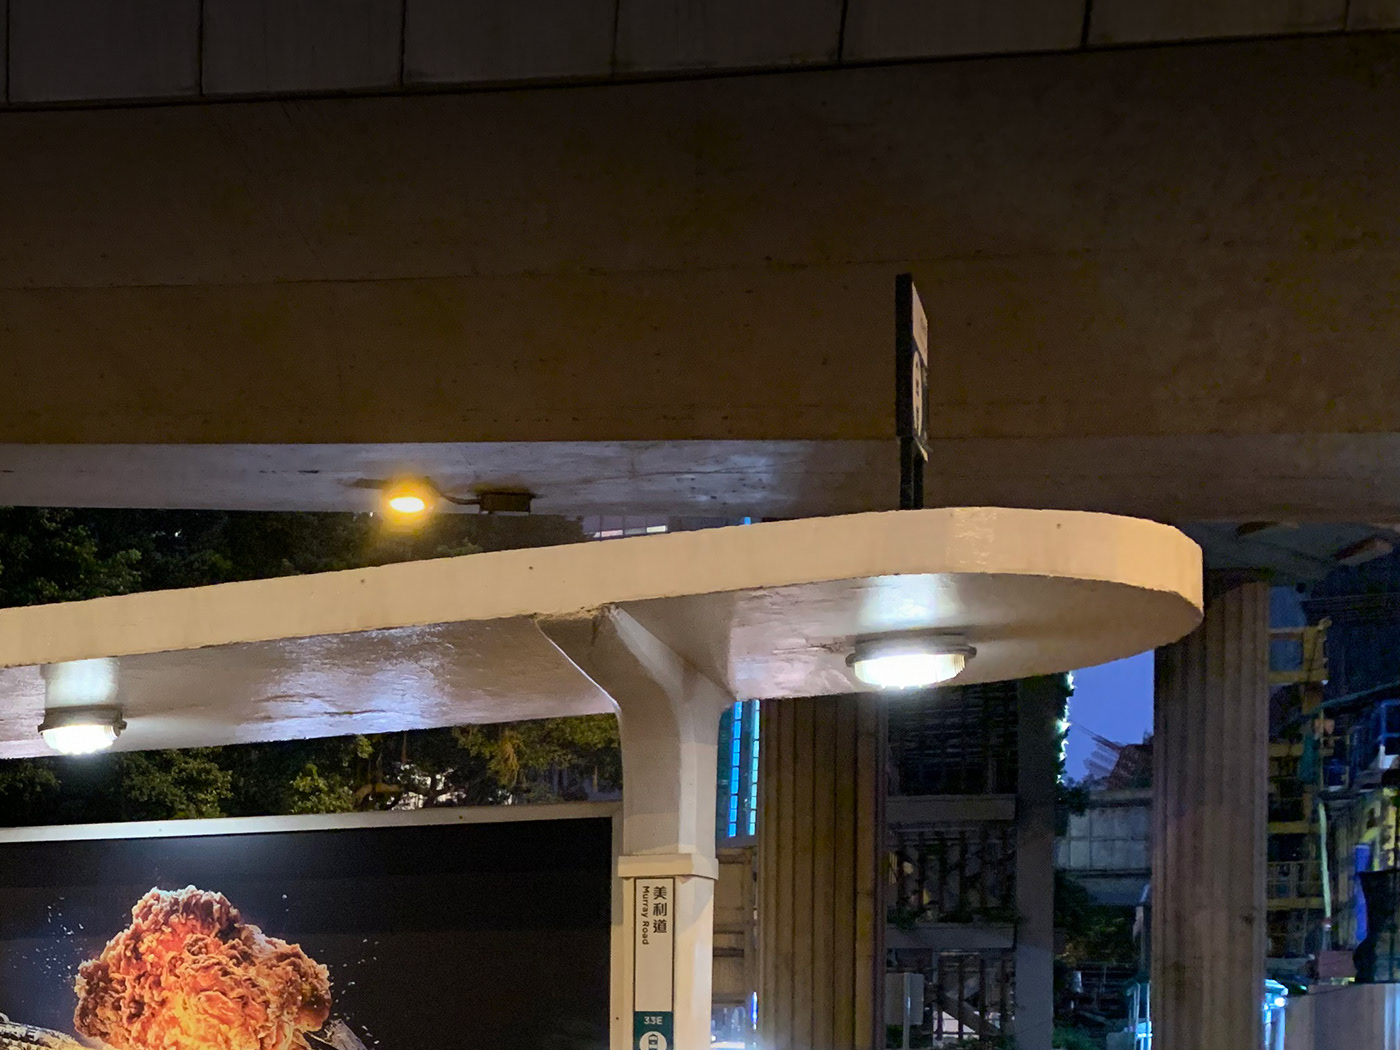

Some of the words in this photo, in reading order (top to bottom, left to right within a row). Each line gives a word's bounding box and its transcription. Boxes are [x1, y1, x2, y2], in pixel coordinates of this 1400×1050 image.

[641, 885, 650, 918] Murray
[652, 885, 668, 934] 美利道
[641, 921, 650, 946] Road
[643, 1015, 664, 1026] 33E
